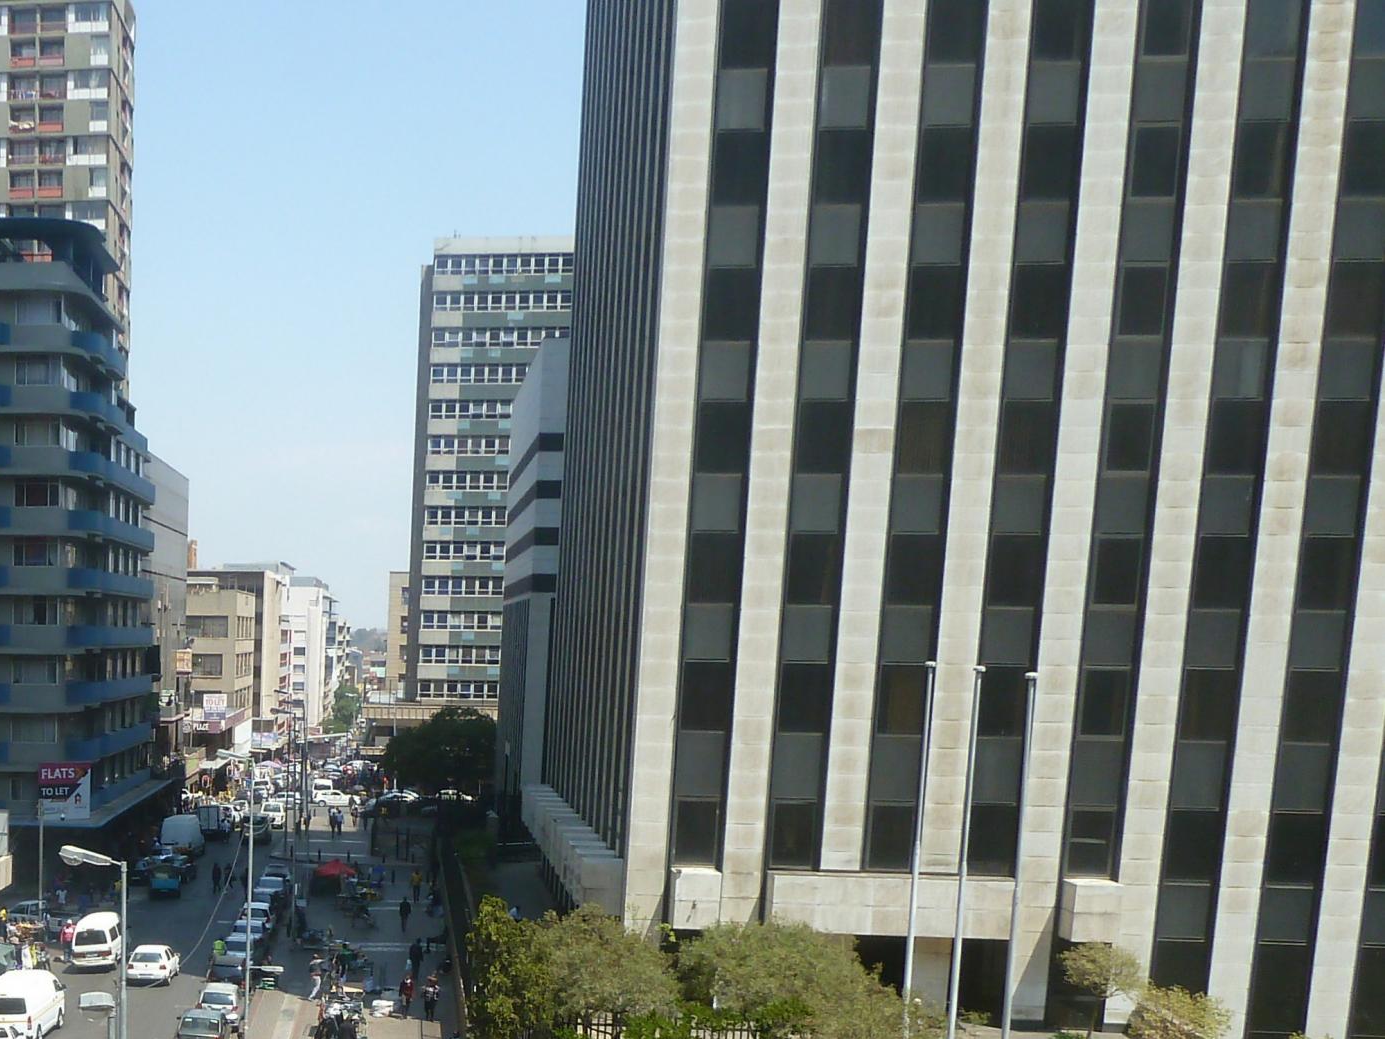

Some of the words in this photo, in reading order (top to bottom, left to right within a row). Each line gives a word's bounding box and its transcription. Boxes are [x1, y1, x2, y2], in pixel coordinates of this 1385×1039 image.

[41, 767, 75, 779] FLATS
[41, 787, 53, 796] TO
[55, 786, 70, 796] LET
